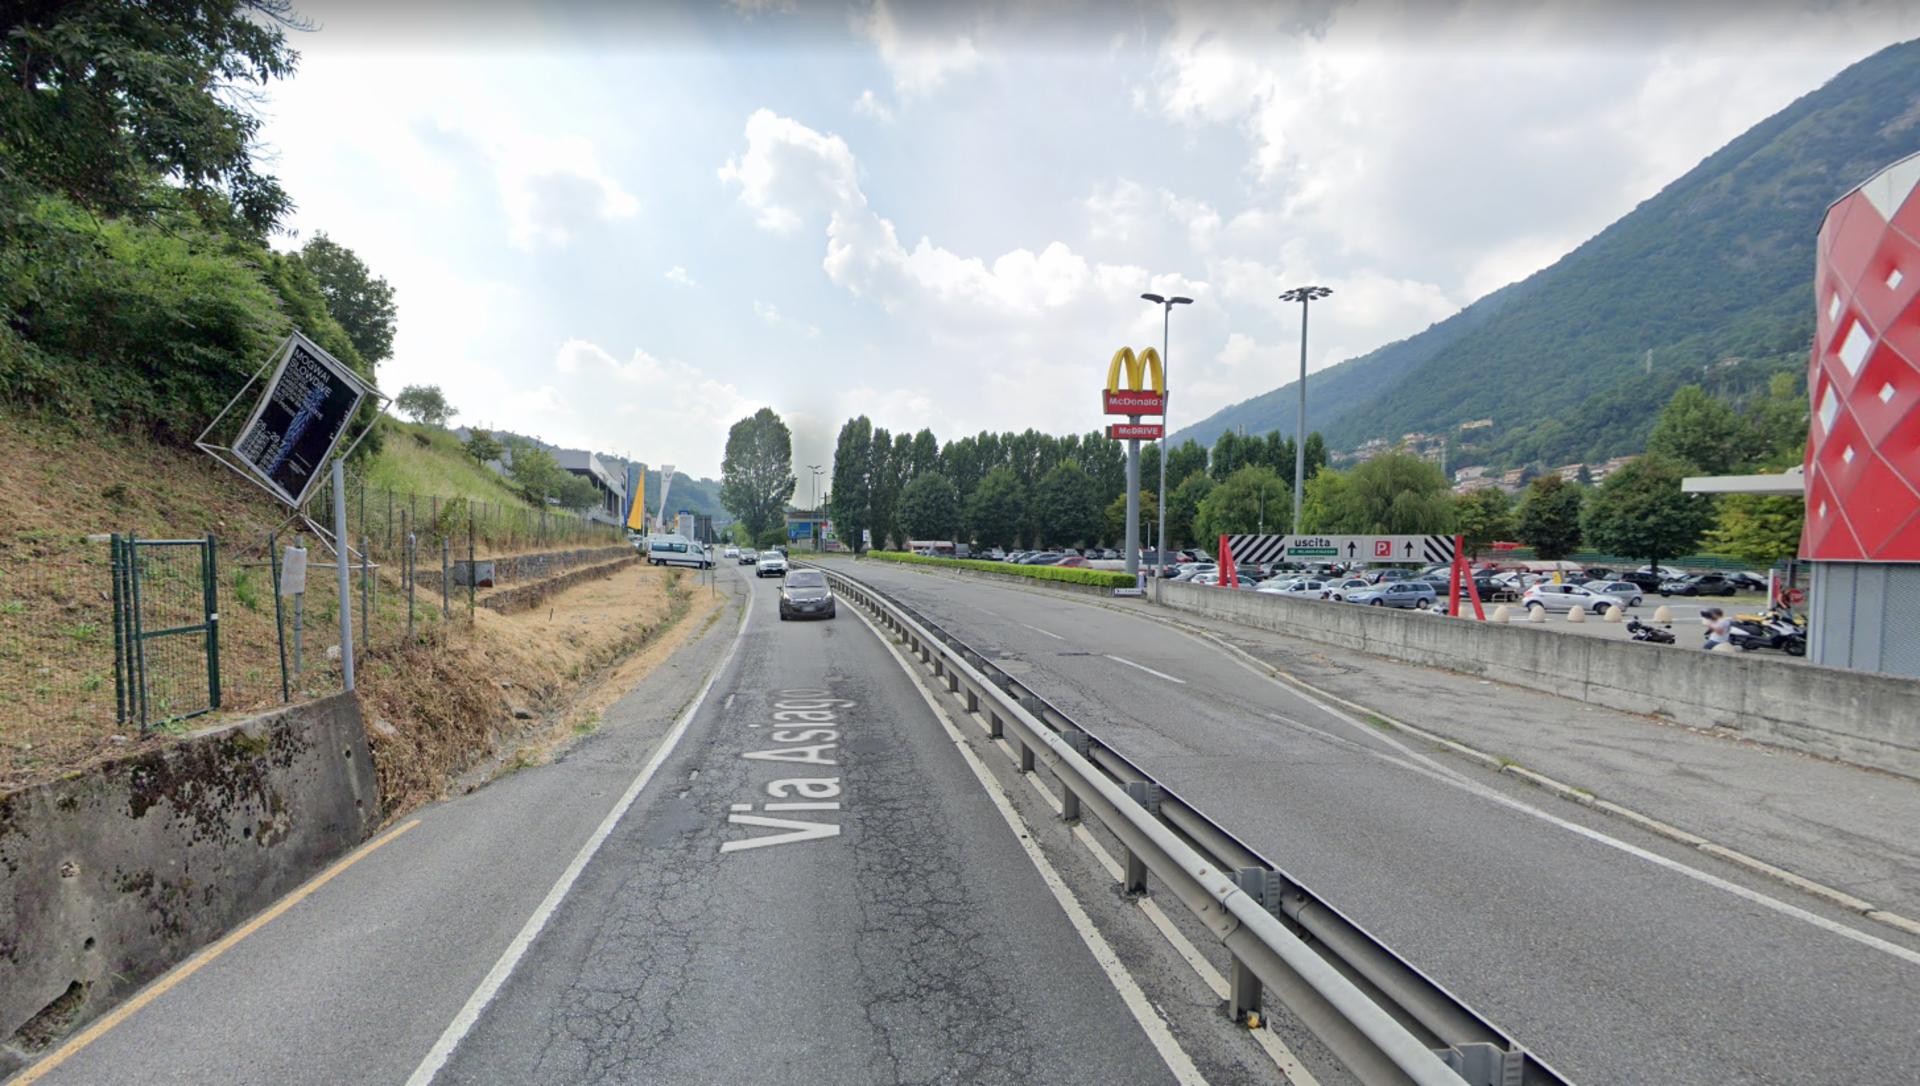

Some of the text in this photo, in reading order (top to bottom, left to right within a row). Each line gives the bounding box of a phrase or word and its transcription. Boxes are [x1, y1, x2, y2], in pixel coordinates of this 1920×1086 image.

[294, 348, 331, 383] MOGWAI
[289, 358, 333, 398] SLOWDIVE
[1109, 397, 1163, 407] McDonald
[1119, 427, 1159, 435] McDRIVE
[1294, 537, 1331, 547] uscita
[719, 689, 856, 853] Via Asiago
